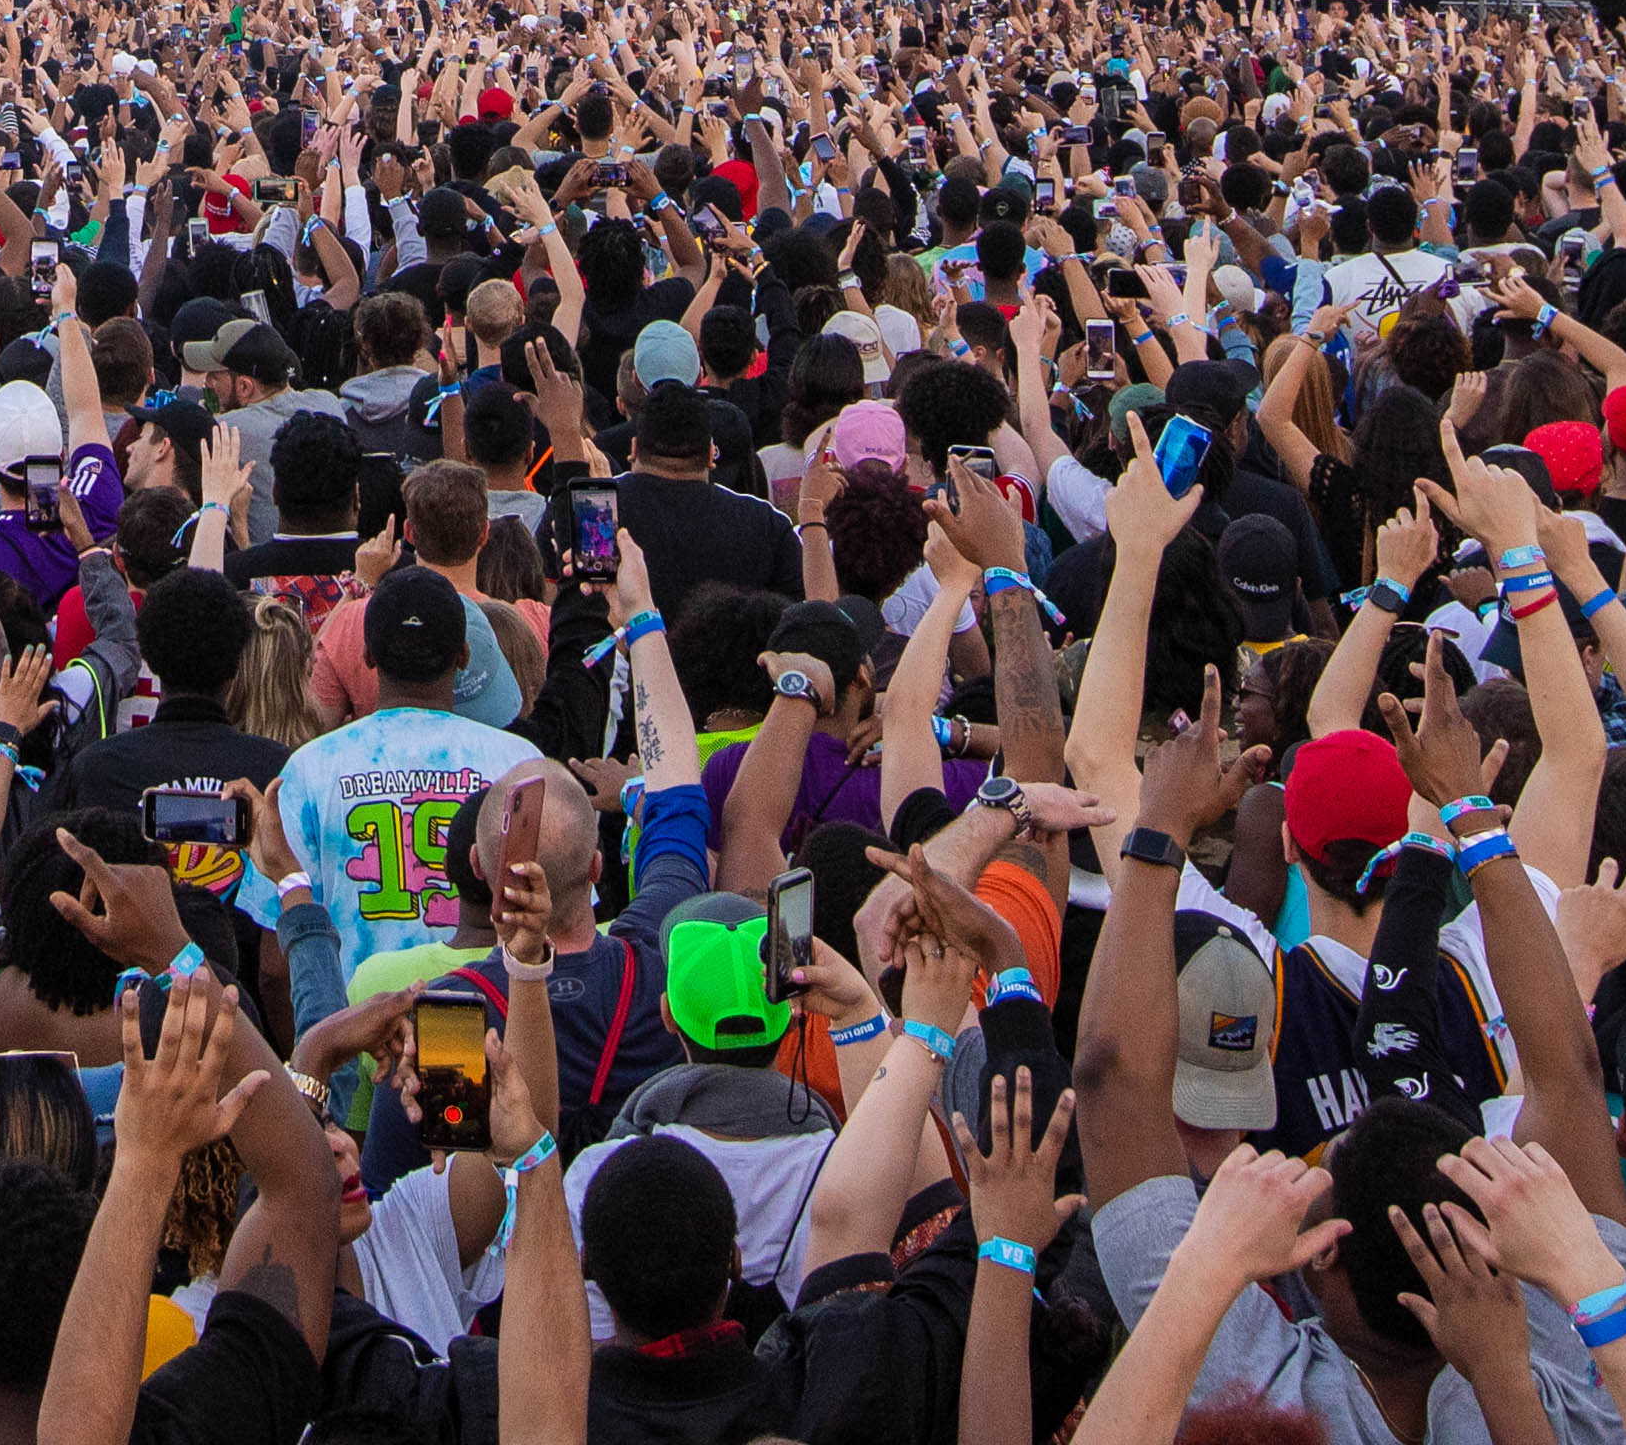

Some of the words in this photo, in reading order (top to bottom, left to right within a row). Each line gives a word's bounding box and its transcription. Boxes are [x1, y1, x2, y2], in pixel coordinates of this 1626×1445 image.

[1233, 576, 1258, 593] Calvin
[1259, 583, 1280, 593] Klein
[341, 769, 481, 798] DREAMVILLE
[852, 1021, 875, 1039] BUD
[1002, 1243, 1024, 1265] GA
